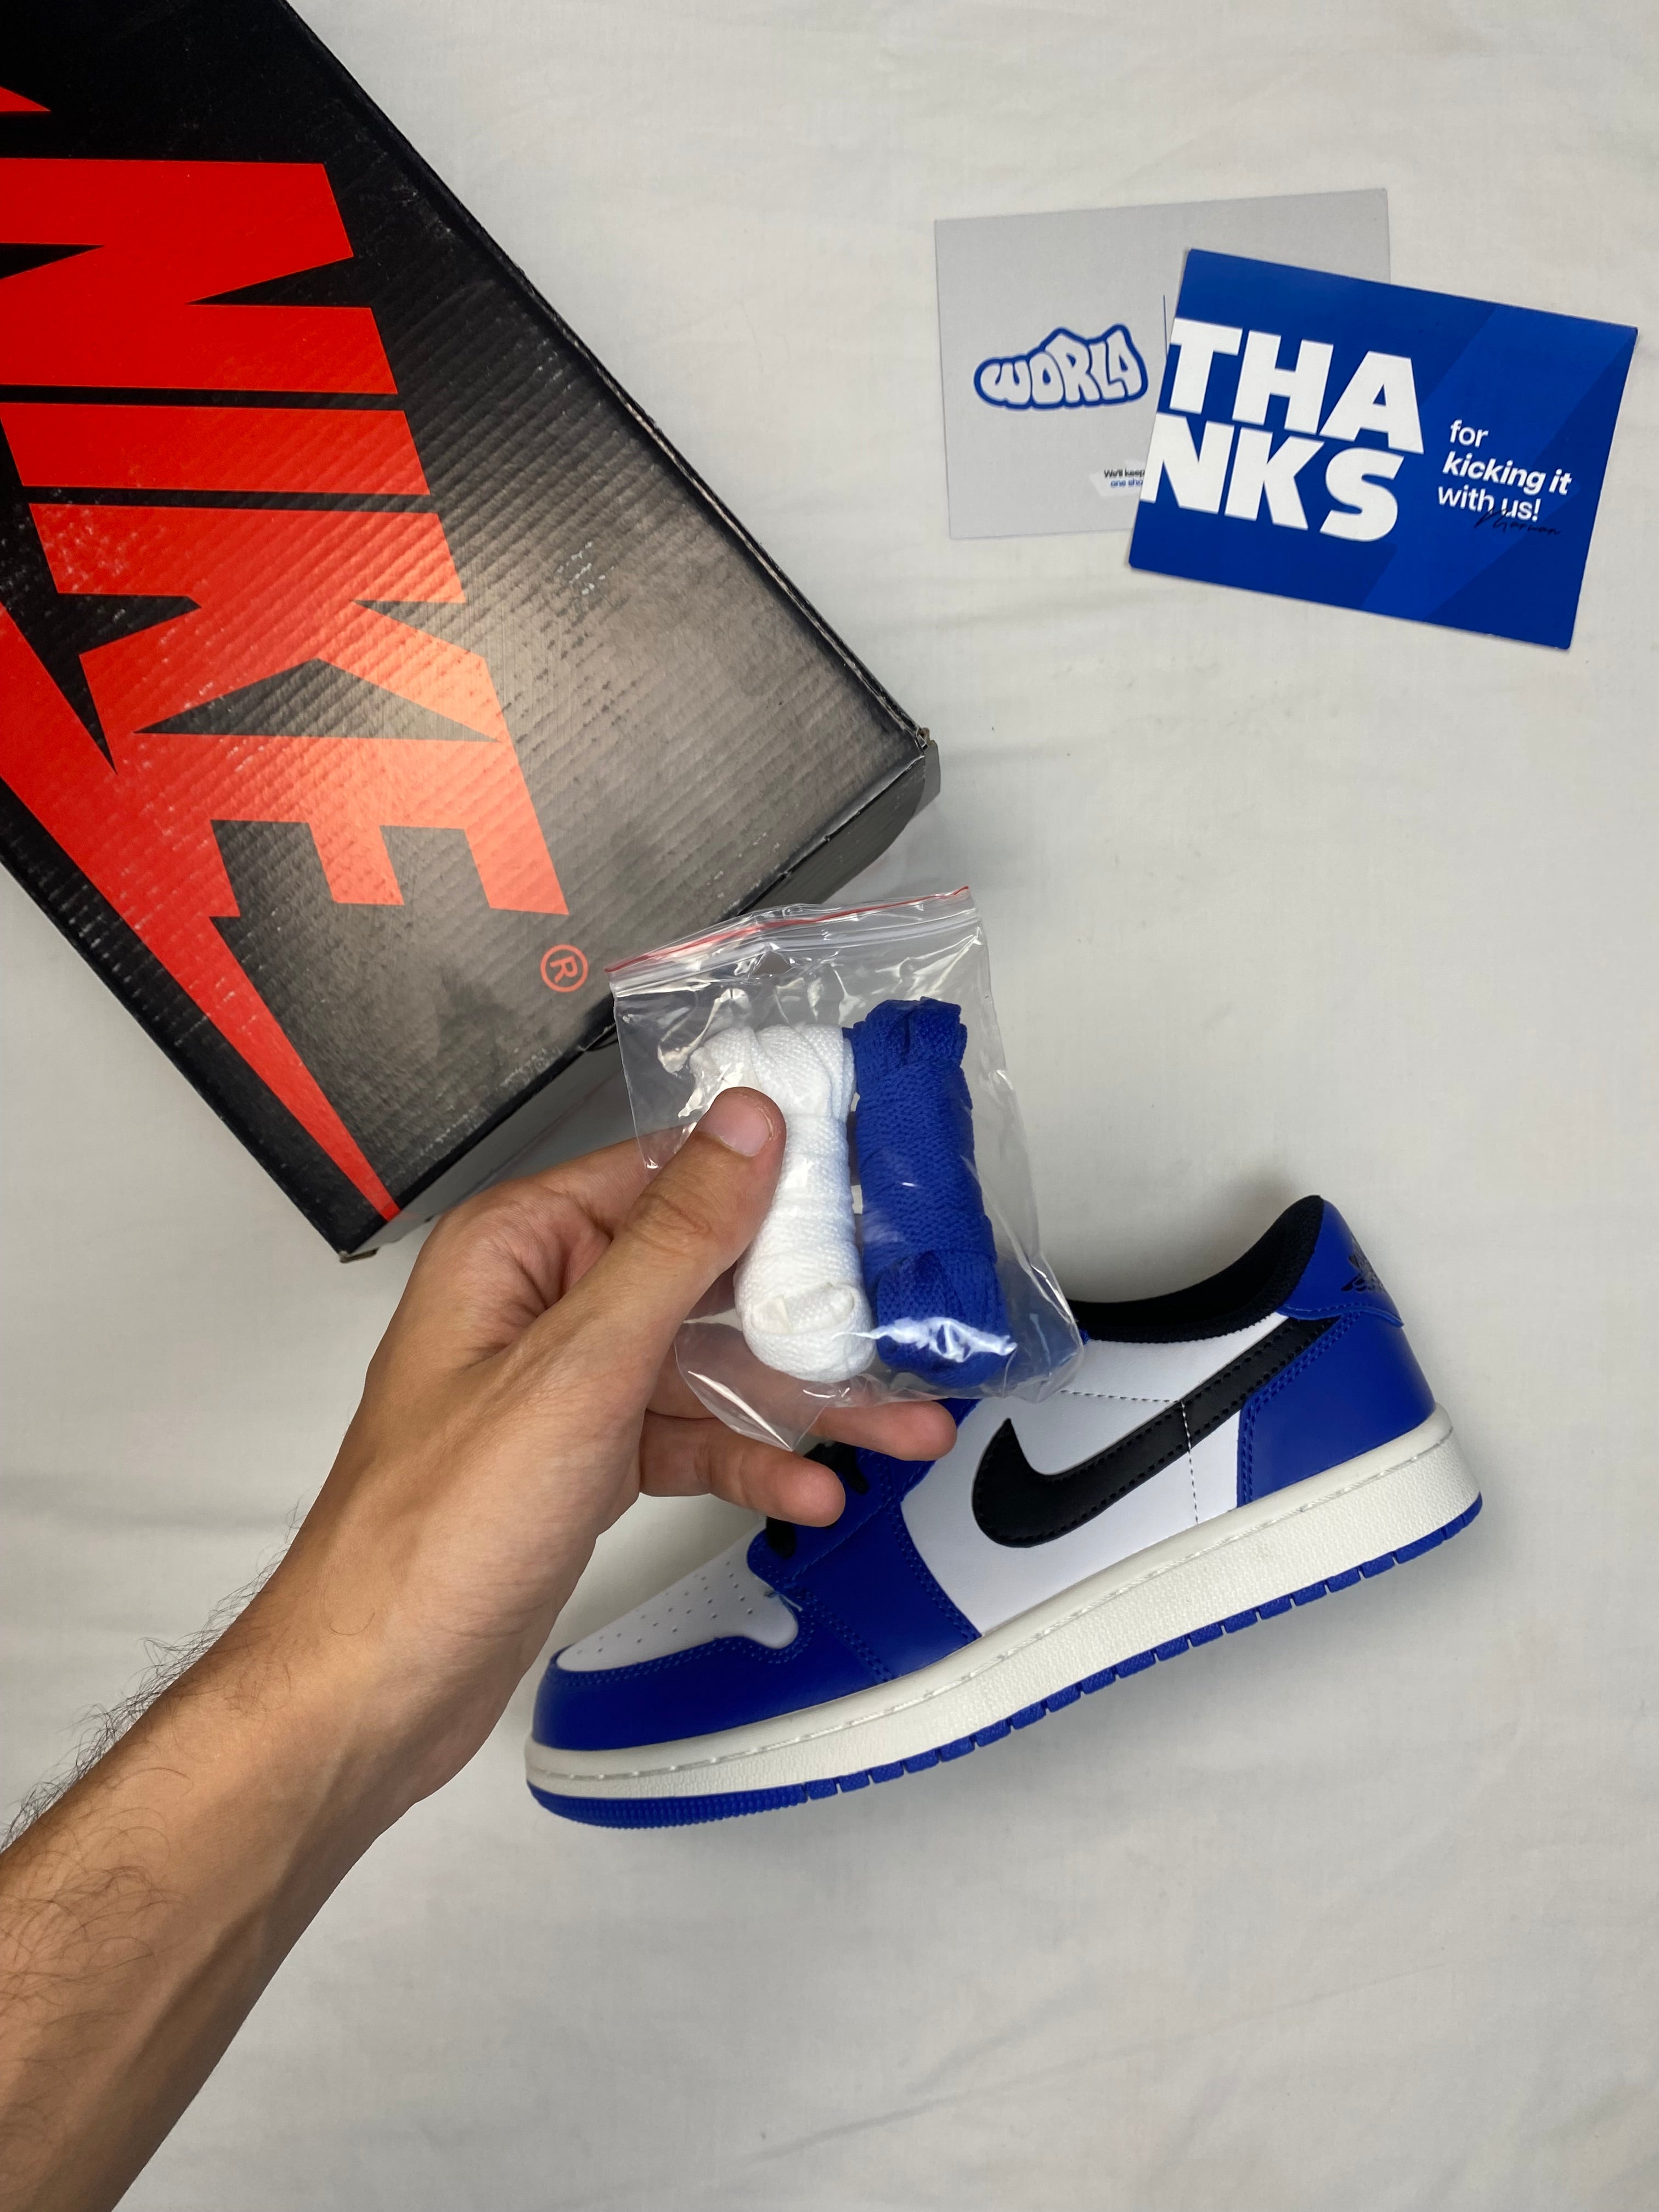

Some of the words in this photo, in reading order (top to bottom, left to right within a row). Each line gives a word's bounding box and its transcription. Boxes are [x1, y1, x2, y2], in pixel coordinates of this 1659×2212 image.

[1169, 317, 1425, 455] THA
[1449, 419, 1489, 448] for
[1104, 469, 1123, 478] We'll
[1110, 479, 1126, 488] one
[1128, 477, 1143, 487] sho
[1139, 412, 1405, 542] NKS
[1442, 450, 1547, 496] kicking
[1548, 468, 1573, 496] it
[1438, 484, 1495, 515] with
[1500, 498, 1542, 522] us!
[0, 158, 568, 918] NIKE
